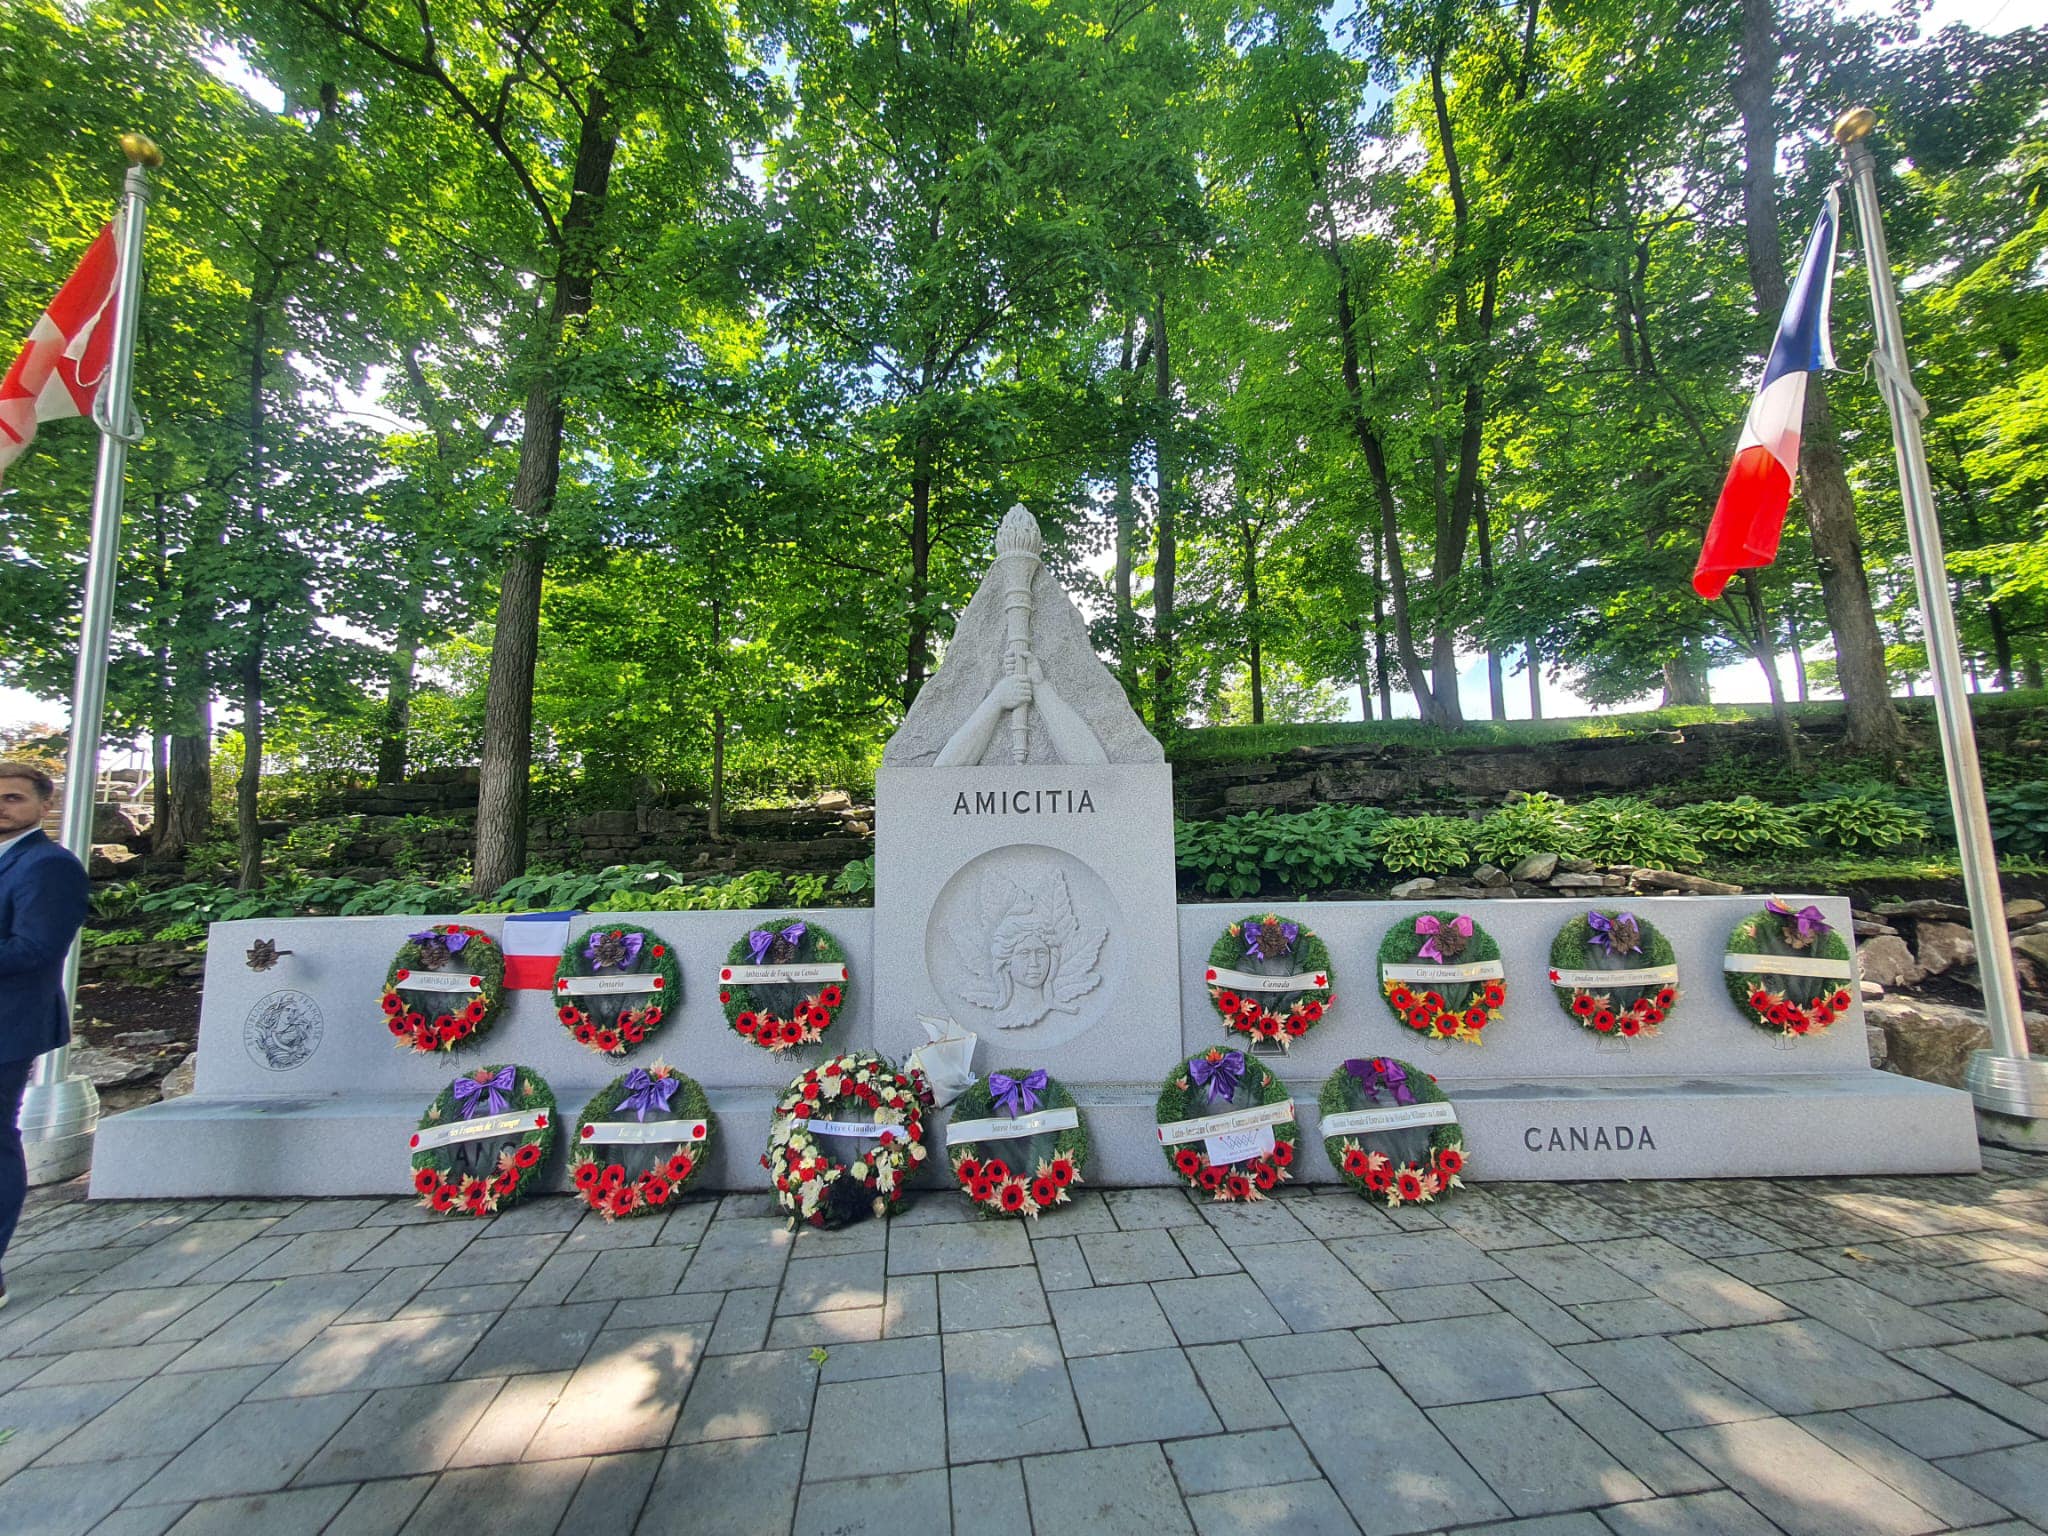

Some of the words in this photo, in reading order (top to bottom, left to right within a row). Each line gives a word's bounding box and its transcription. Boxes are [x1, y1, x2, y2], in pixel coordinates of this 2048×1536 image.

[953, 790, 1095, 815] AMICITIA
[1416, 969, 1427, 977] City
[598, 980, 625, 989] Ontario
[1262, 979, 1290, 988] Canada
[1524, 1126, 1657, 1152] CANADA
